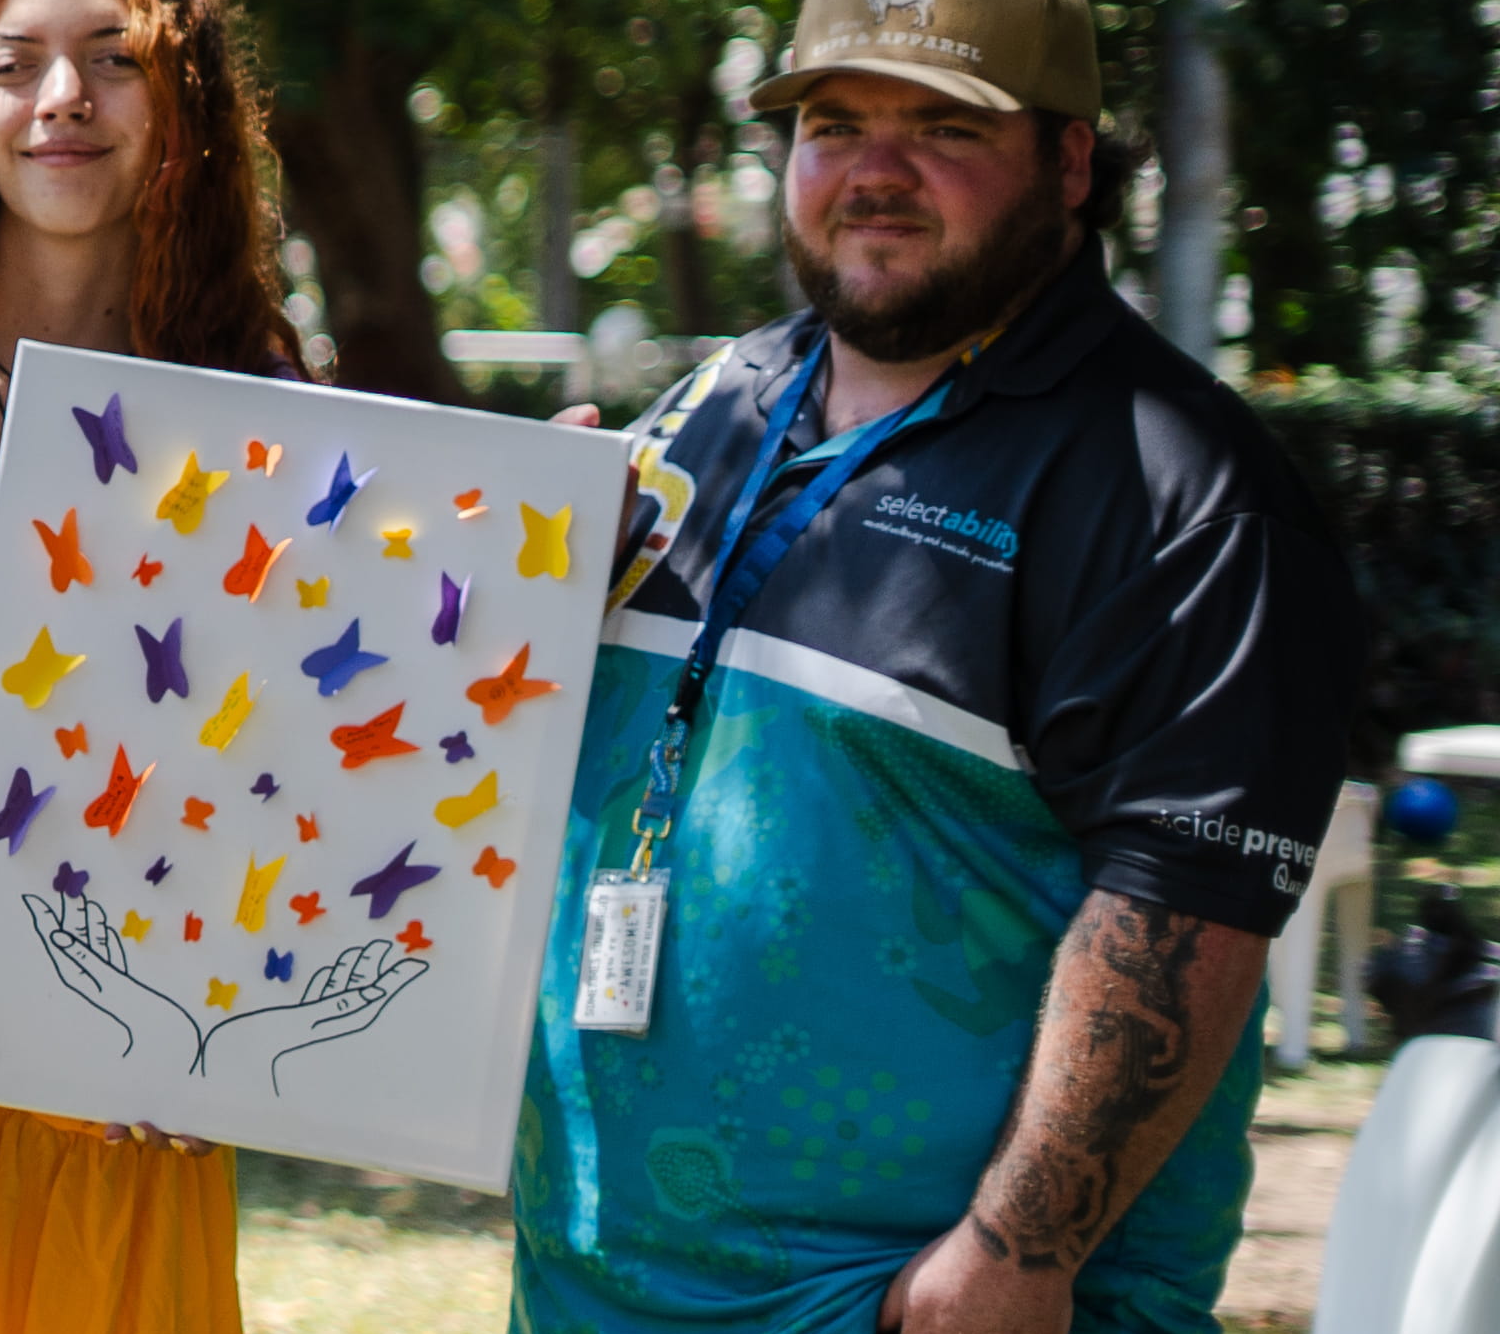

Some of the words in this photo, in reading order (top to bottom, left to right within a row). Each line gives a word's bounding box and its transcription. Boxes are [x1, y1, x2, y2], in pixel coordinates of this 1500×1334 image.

[876, 31, 983, 63] APPAREL
[876, 493, 1019, 559] selectability
[1155, 808, 1241, 846] cide
[1242, 826, 1319, 868] preve
